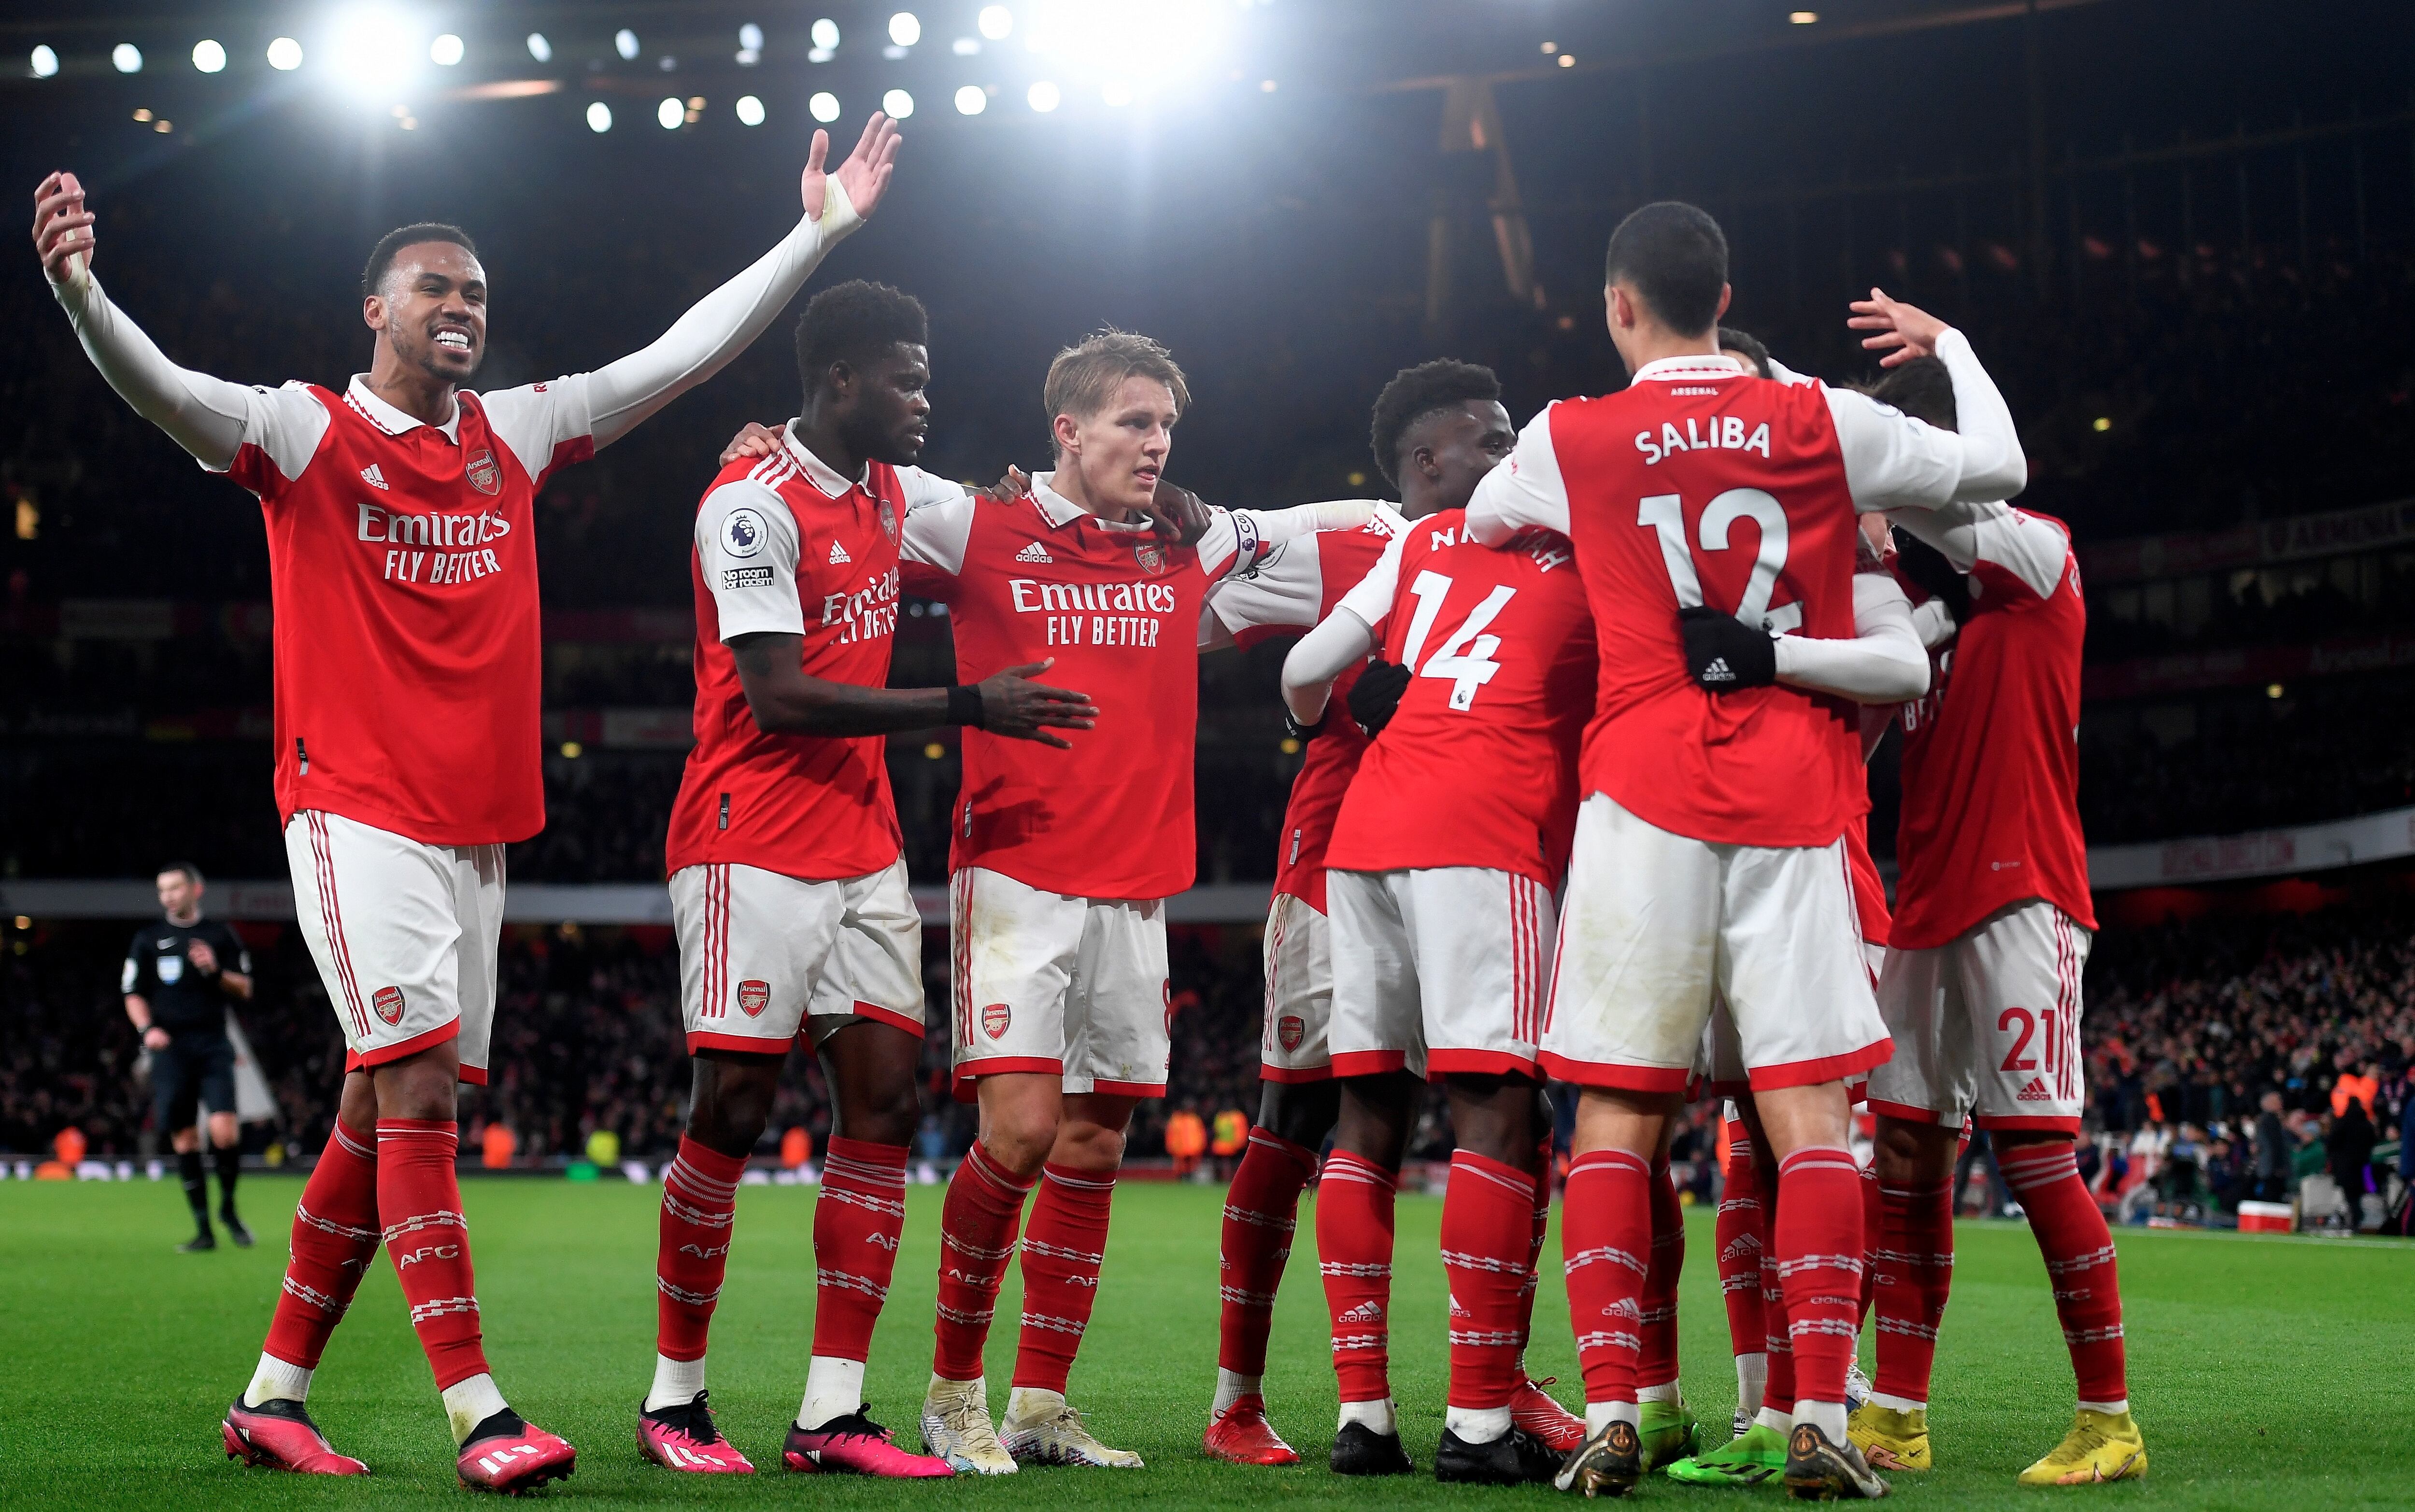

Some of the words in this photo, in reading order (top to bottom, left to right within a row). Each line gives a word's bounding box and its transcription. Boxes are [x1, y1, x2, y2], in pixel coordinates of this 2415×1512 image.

[1670, 387, 1719, 396] ARSENAL
[1635, 415, 1770, 466] SALIBA
[467, 455, 490, 471] Arsenal
[829, 554, 852, 565] adidas
[1015, 551, 1053, 564] adidas
[1637, 487, 1804, 633] 12
[385, 550, 425, 582] FLY
[430, 549, 502, 584] BETTER
[722, 570, 738, 580] No
[739, 568, 768, 579] room
[723, 579, 739, 590] for
[739, 577, 773, 588] racism
[1008, 579, 1175, 613] Emirates
[1047, 616, 1083, 646] FLY
[1092, 617, 1159, 648] BETTER
[1402, 569, 1518, 711] 14
[375, 989, 398, 1003] Arsenal
[741, 984, 766, 993] Arsenal
[1998, 1007, 2056, 1073] 21
[400, 1244, 459, 1270] AFC
[949, 1269, 997, 1286] AFC
